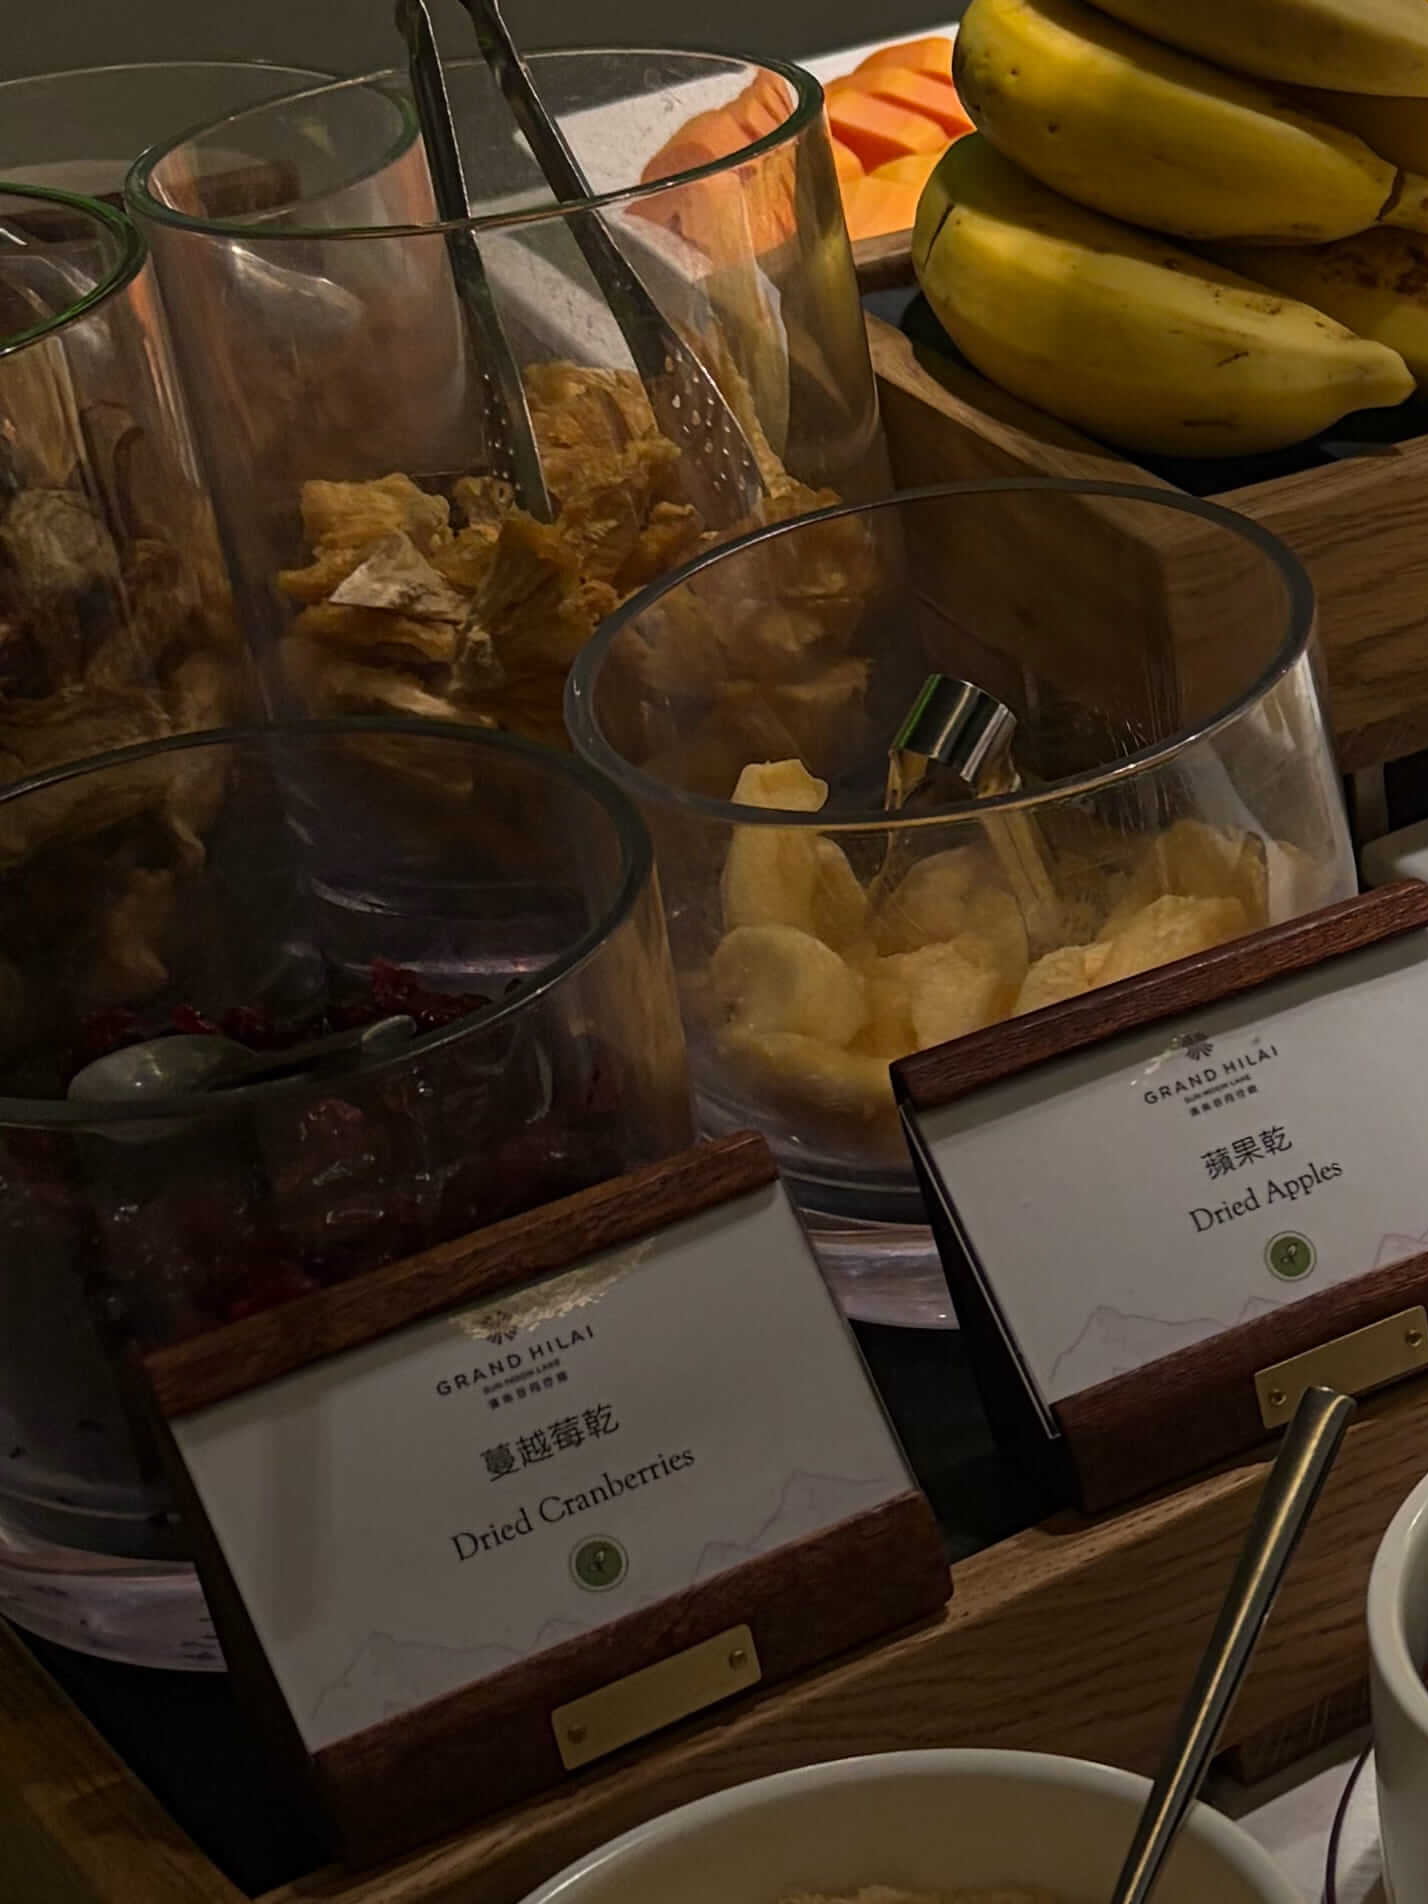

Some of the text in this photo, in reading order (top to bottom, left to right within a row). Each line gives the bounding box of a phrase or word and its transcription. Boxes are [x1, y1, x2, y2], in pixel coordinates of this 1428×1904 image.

[1143, 1068, 1217, 1105] GRAND
[1223, 1045, 1279, 1074] HILAI
[1200, 1125, 1293, 1180] 蘋果乾
[1189, 1161, 1344, 1232] Dried Apples
[436, 1353, 521, 1396] GRAND
[528, 1325, 594, 1360] HILAI
[480, 1403, 620, 1482] 蔓越莓乾
[451, 1448, 695, 1561] Dried Cranberries
